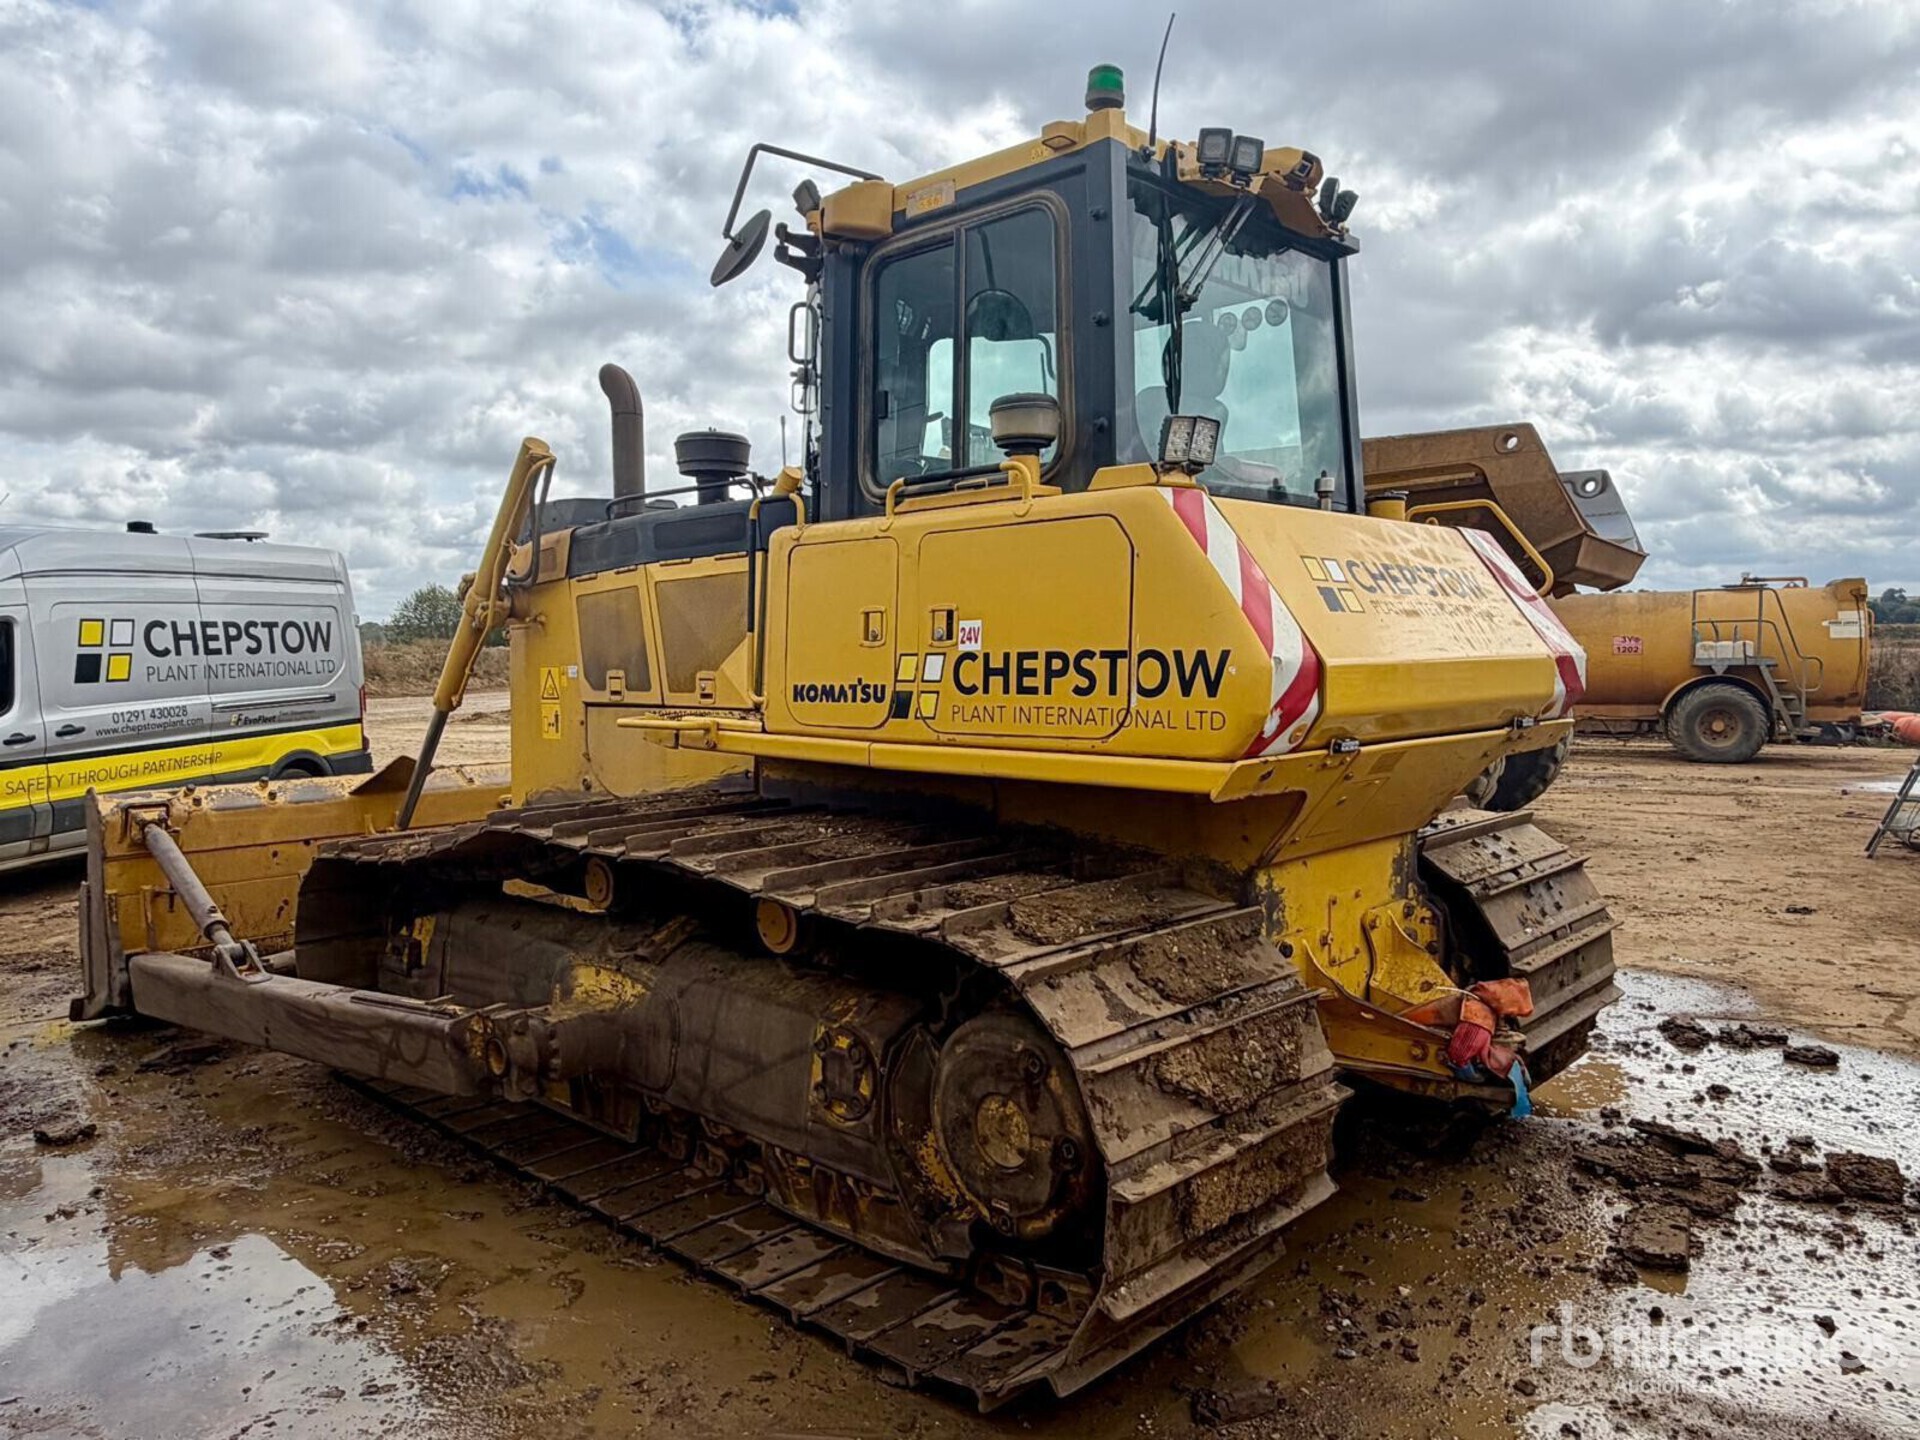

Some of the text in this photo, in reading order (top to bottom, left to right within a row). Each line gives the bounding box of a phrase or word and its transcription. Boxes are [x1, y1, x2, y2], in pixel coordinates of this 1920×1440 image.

[143, 620, 332, 658] CHEPSTOW
[960, 627, 981, 644] 24V
[1617, 646, 1639, 654] 1202
[146, 660, 336, 682] PLANT INTERNATIONAL LTD
[953, 650, 1232, 698] CHEPSTOW
[793, 677, 886, 704] KOMATSU
[96, 716, 204, 736] www.chepstowplant.com
[112, 705, 188, 724] 01291 430028
[951, 705, 1226, 731] PLANT INTERNATIONAL LTD
[5, 752, 223, 795] SAFETY THROUGH PARTNERSHIP
